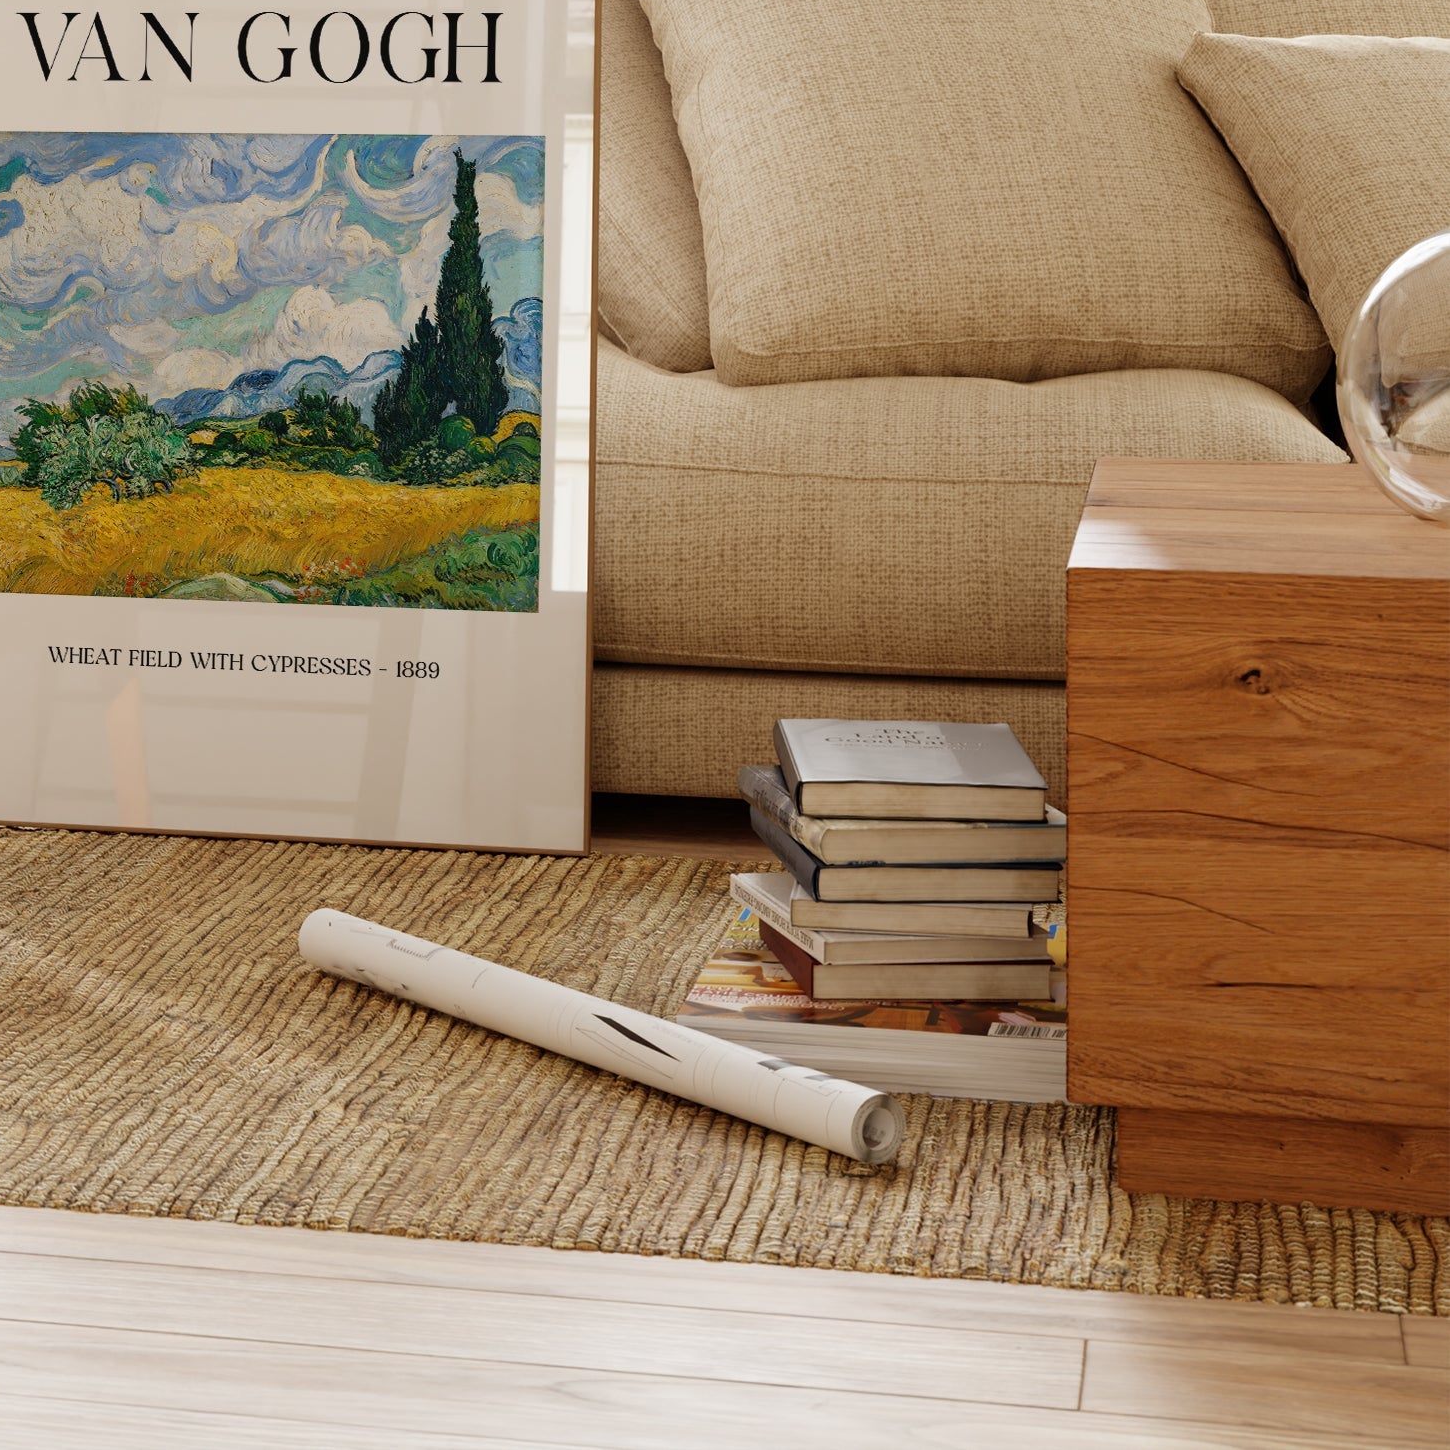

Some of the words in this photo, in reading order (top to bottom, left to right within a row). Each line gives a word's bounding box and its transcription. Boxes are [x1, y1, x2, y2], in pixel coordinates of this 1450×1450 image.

[16, 12, 199, 82] VAN
[238, 12, 503, 83] GOGH
[48, 646, 122, 665] WHEAT
[129, 650, 182, 668] FIELD
[190, 652, 243, 670] WITH
[251, 655, 371, 676] CYPRESSES
[397, 661, 439, 678] 1889
